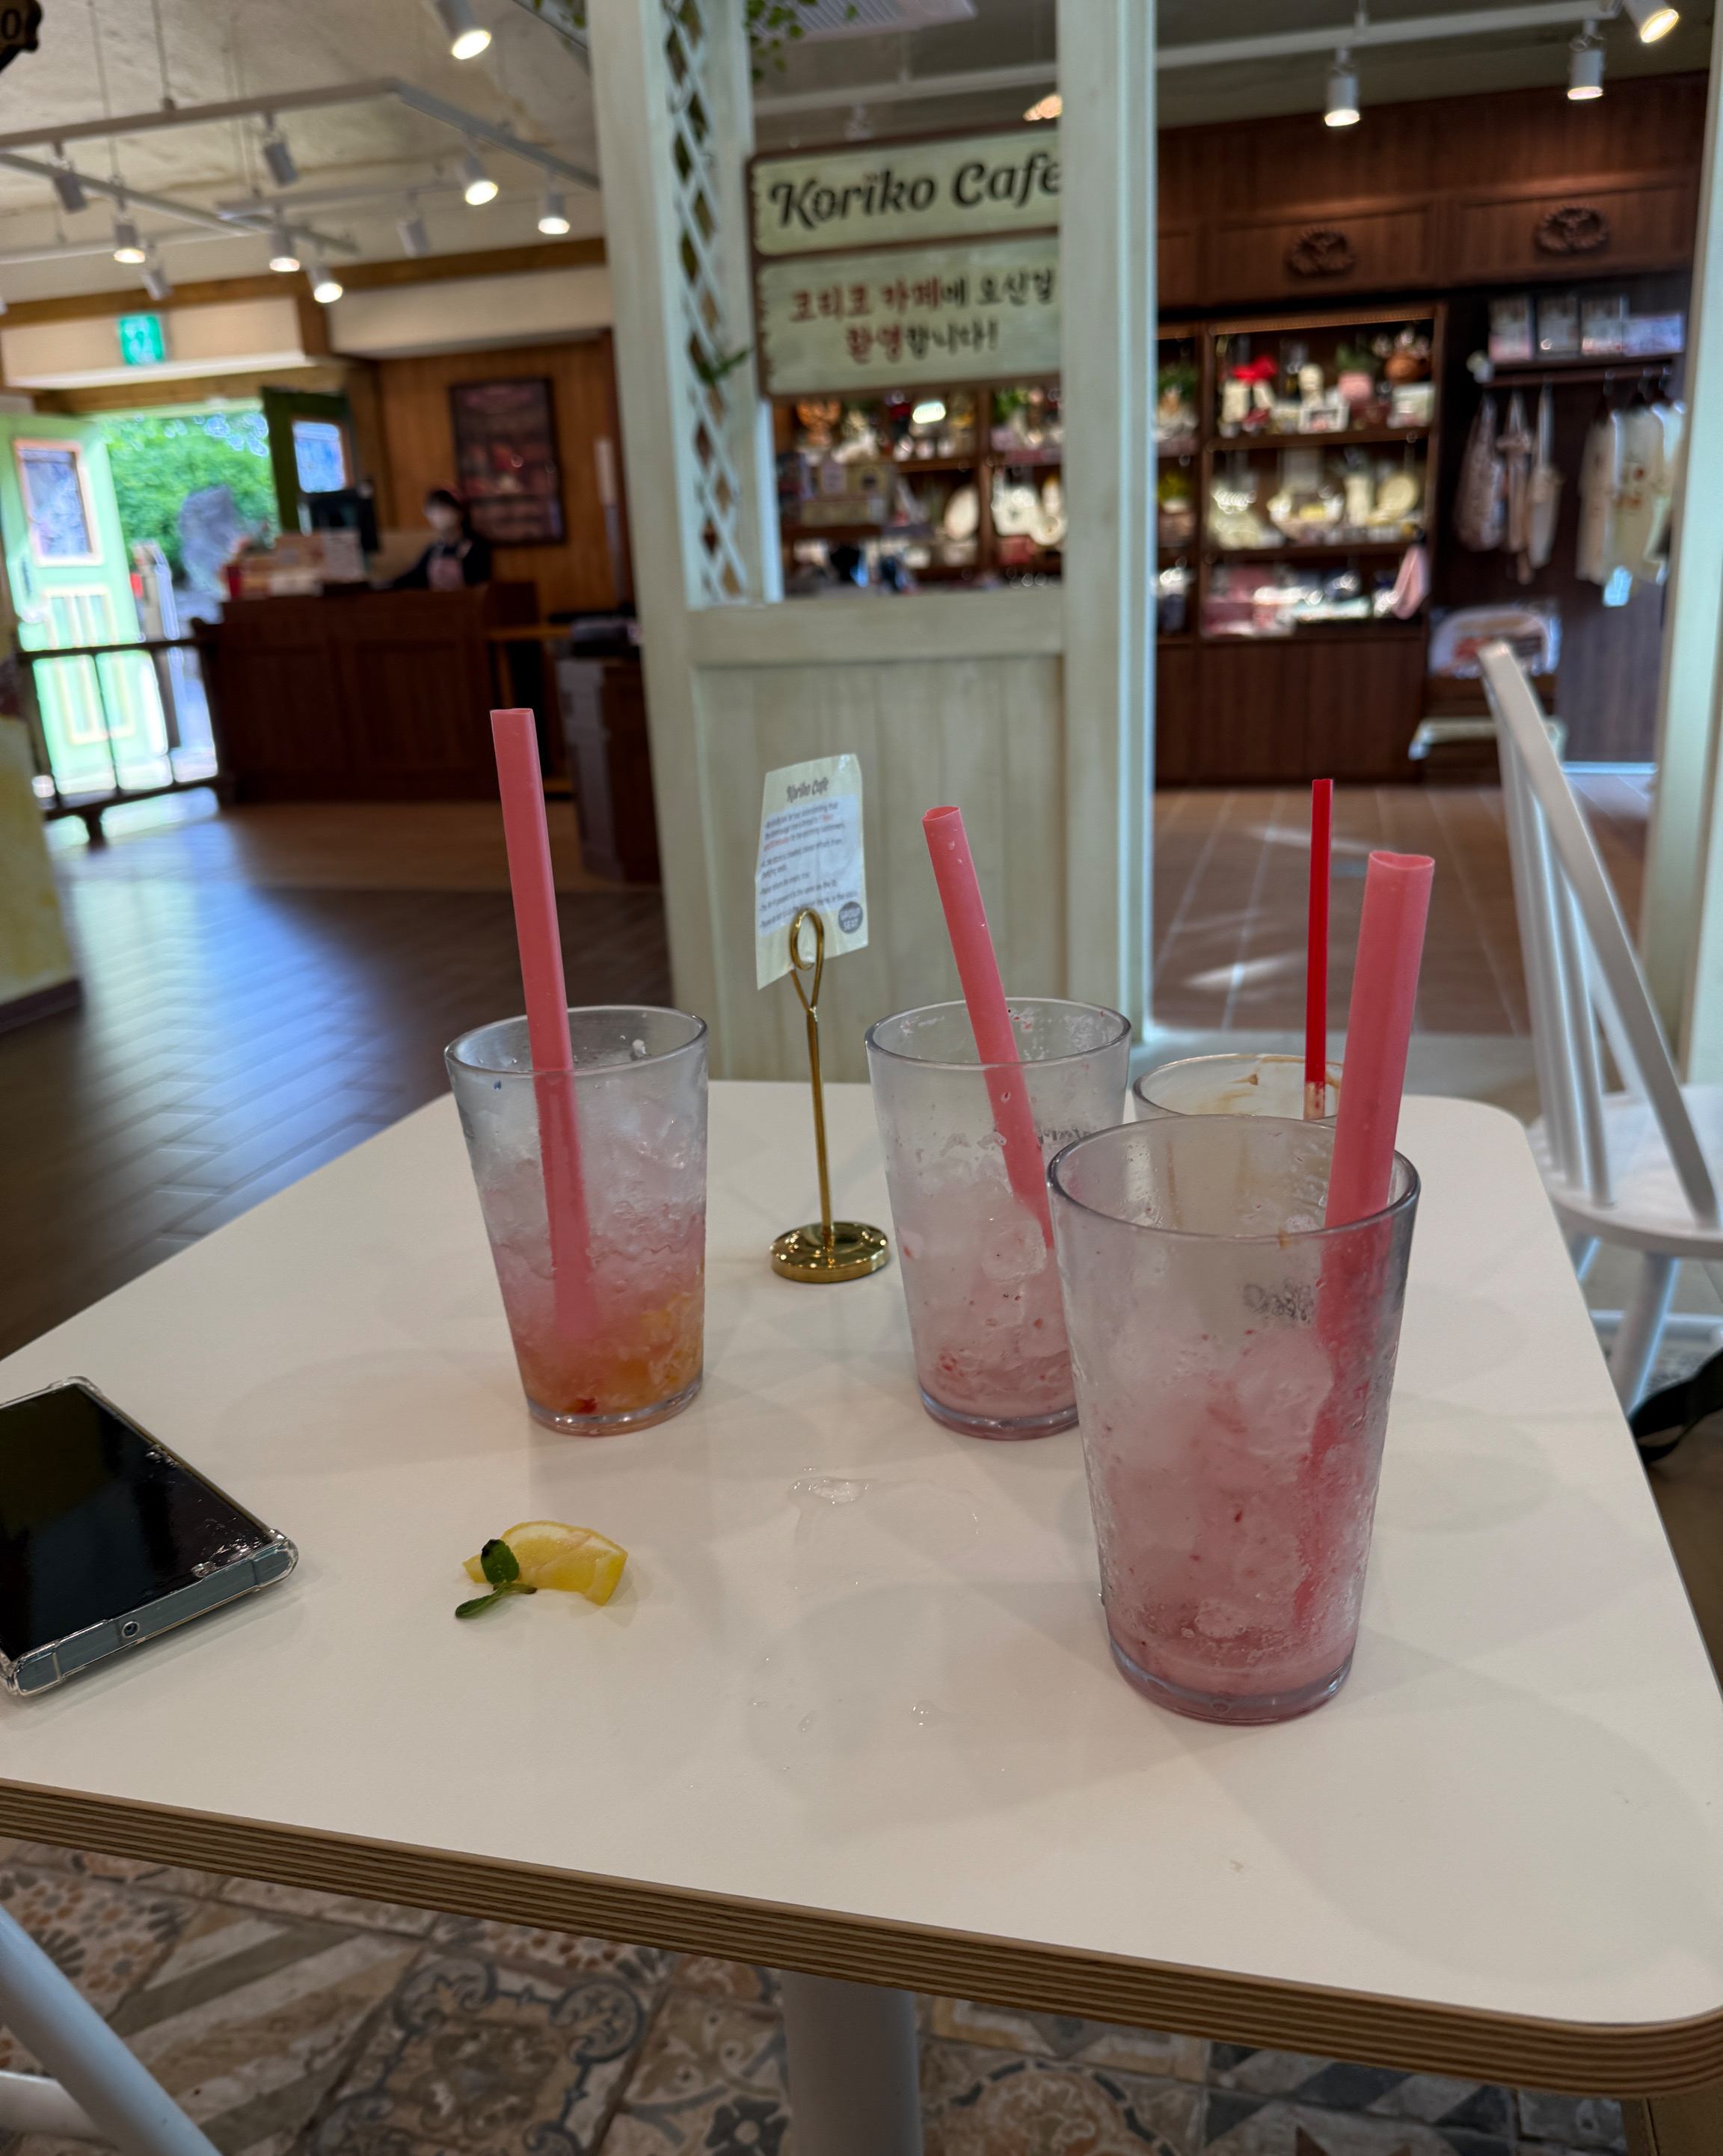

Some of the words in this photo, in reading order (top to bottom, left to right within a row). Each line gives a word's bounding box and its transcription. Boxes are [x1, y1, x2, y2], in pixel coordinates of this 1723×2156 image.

[770, 169, 936, 230] Koriko
[788, 281, 873, 323] 코리코
[879, 274, 970, 316] 카페에
[846, 317, 1000, 365] 환영합니다!
